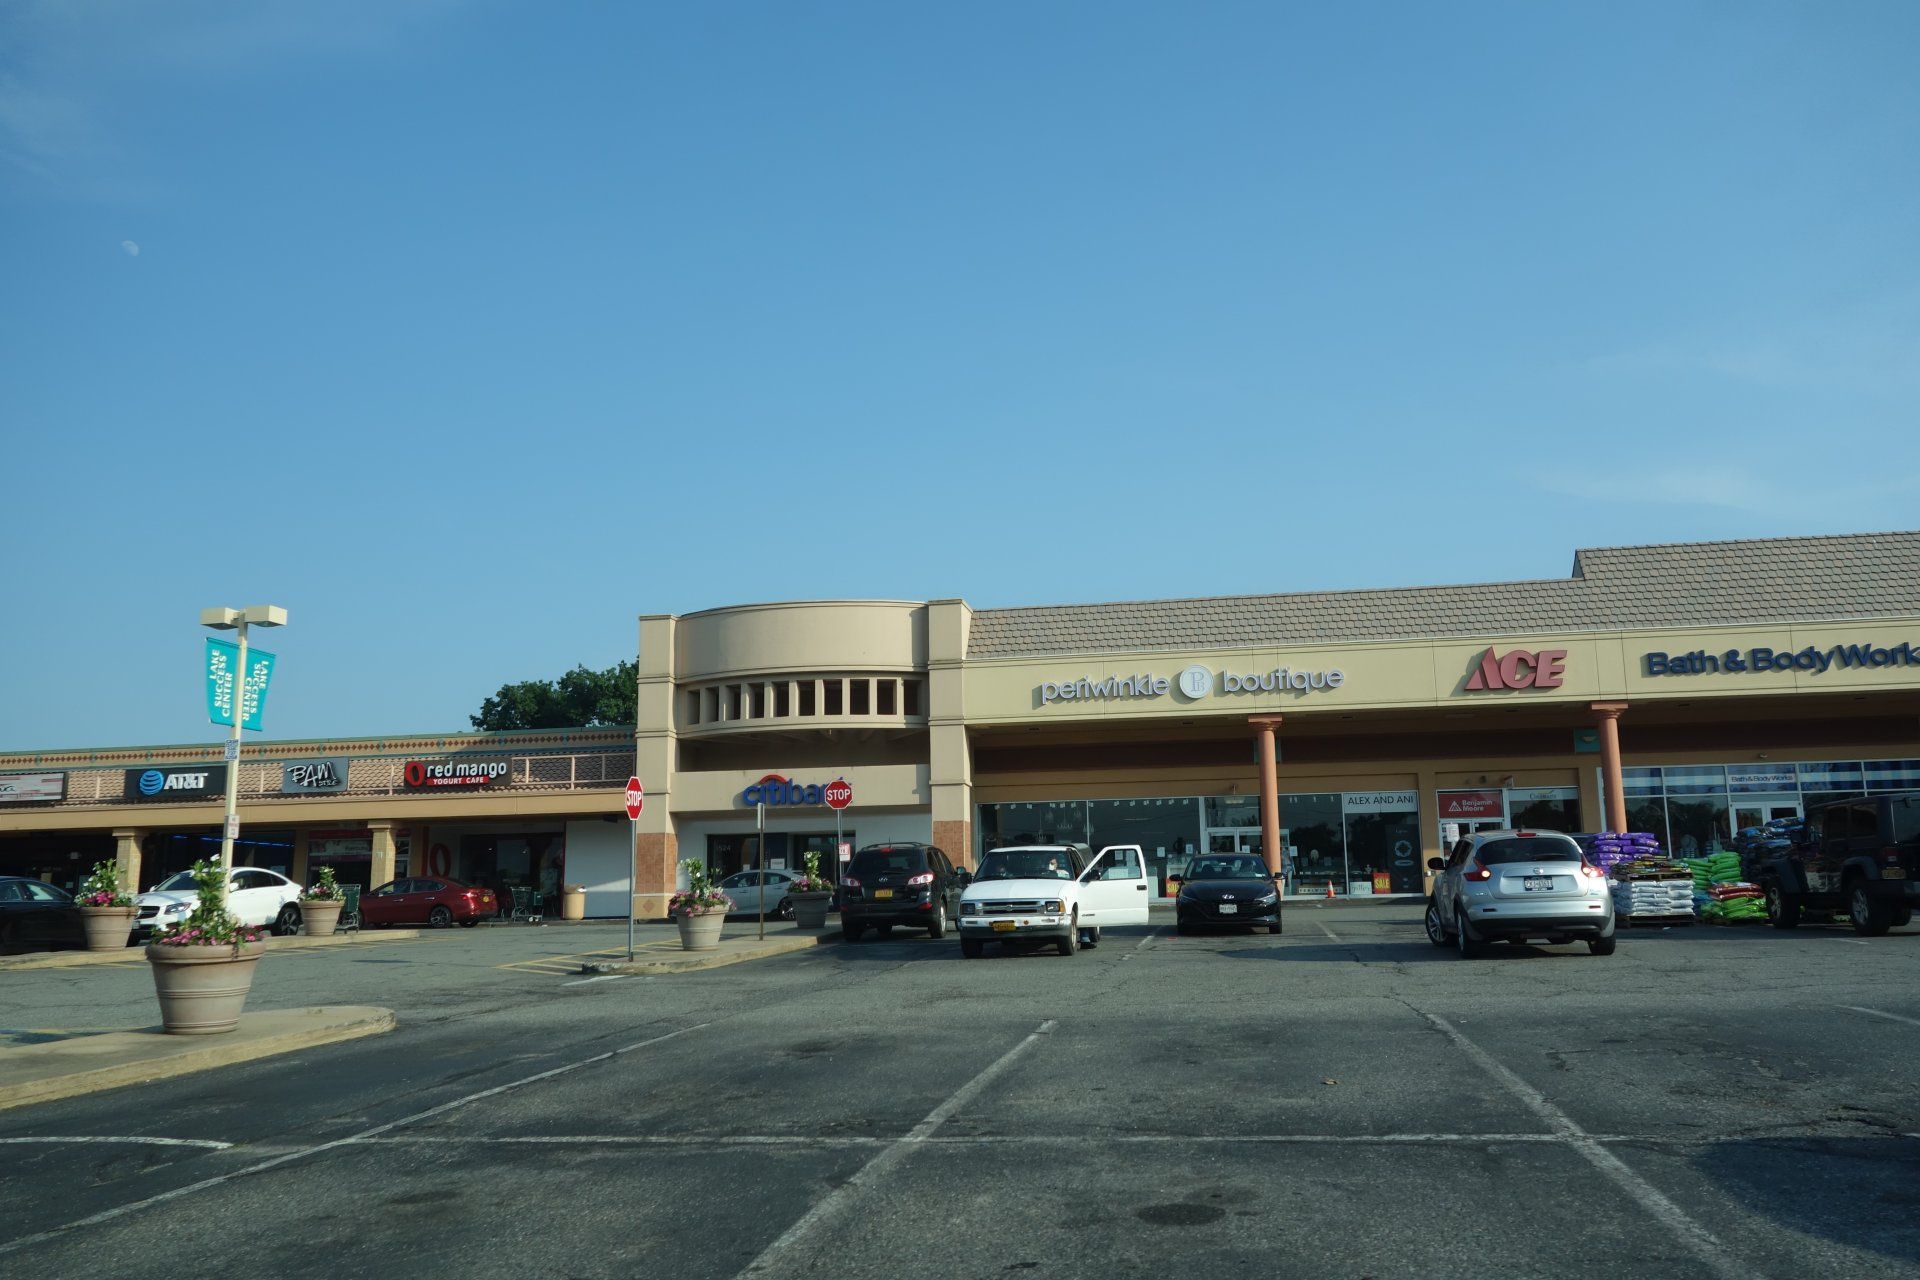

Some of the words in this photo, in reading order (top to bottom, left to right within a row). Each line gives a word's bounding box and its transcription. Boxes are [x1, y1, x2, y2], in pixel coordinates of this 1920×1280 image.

[209, 649, 220, 680] LAKE
[1464, 645, 1568, 690] ACE
[1648, 650, 1719, 675] Bath
[1725, 649, 1748, 673] &
[1752, 646, 1834, 673] Body
[1837, 642, 1920, 667] Work
[214, 655, 227, 707] SUCCESS
[249, 663, 261, 714] SUCCESS
[258, 661, 269, 689] LAKE
[1041, 672, 1170, 704] periwinkle
[1223, 667, 1345, 696] boutique
[221, 672, 233, 717] CENTER
[242, 677, 253, 721] CENTER
[163, 773, 209, 790] AT&T
[286, 761, 337, 787] BAM
[426, 761, 453, 778] red
[456, 762, 507, 778] mango
[626, 790, 642, 807] STOP
[742, 777, 852, 806] citiba
[826, 789, 851, 801] STOP
[1348, 796, 1371, 806] ALEX
[1373, 796, 1395, 805] AND
[1396, 796, 1414, 804] ANI
[1461, 799, 1493, 807] Benjamin
